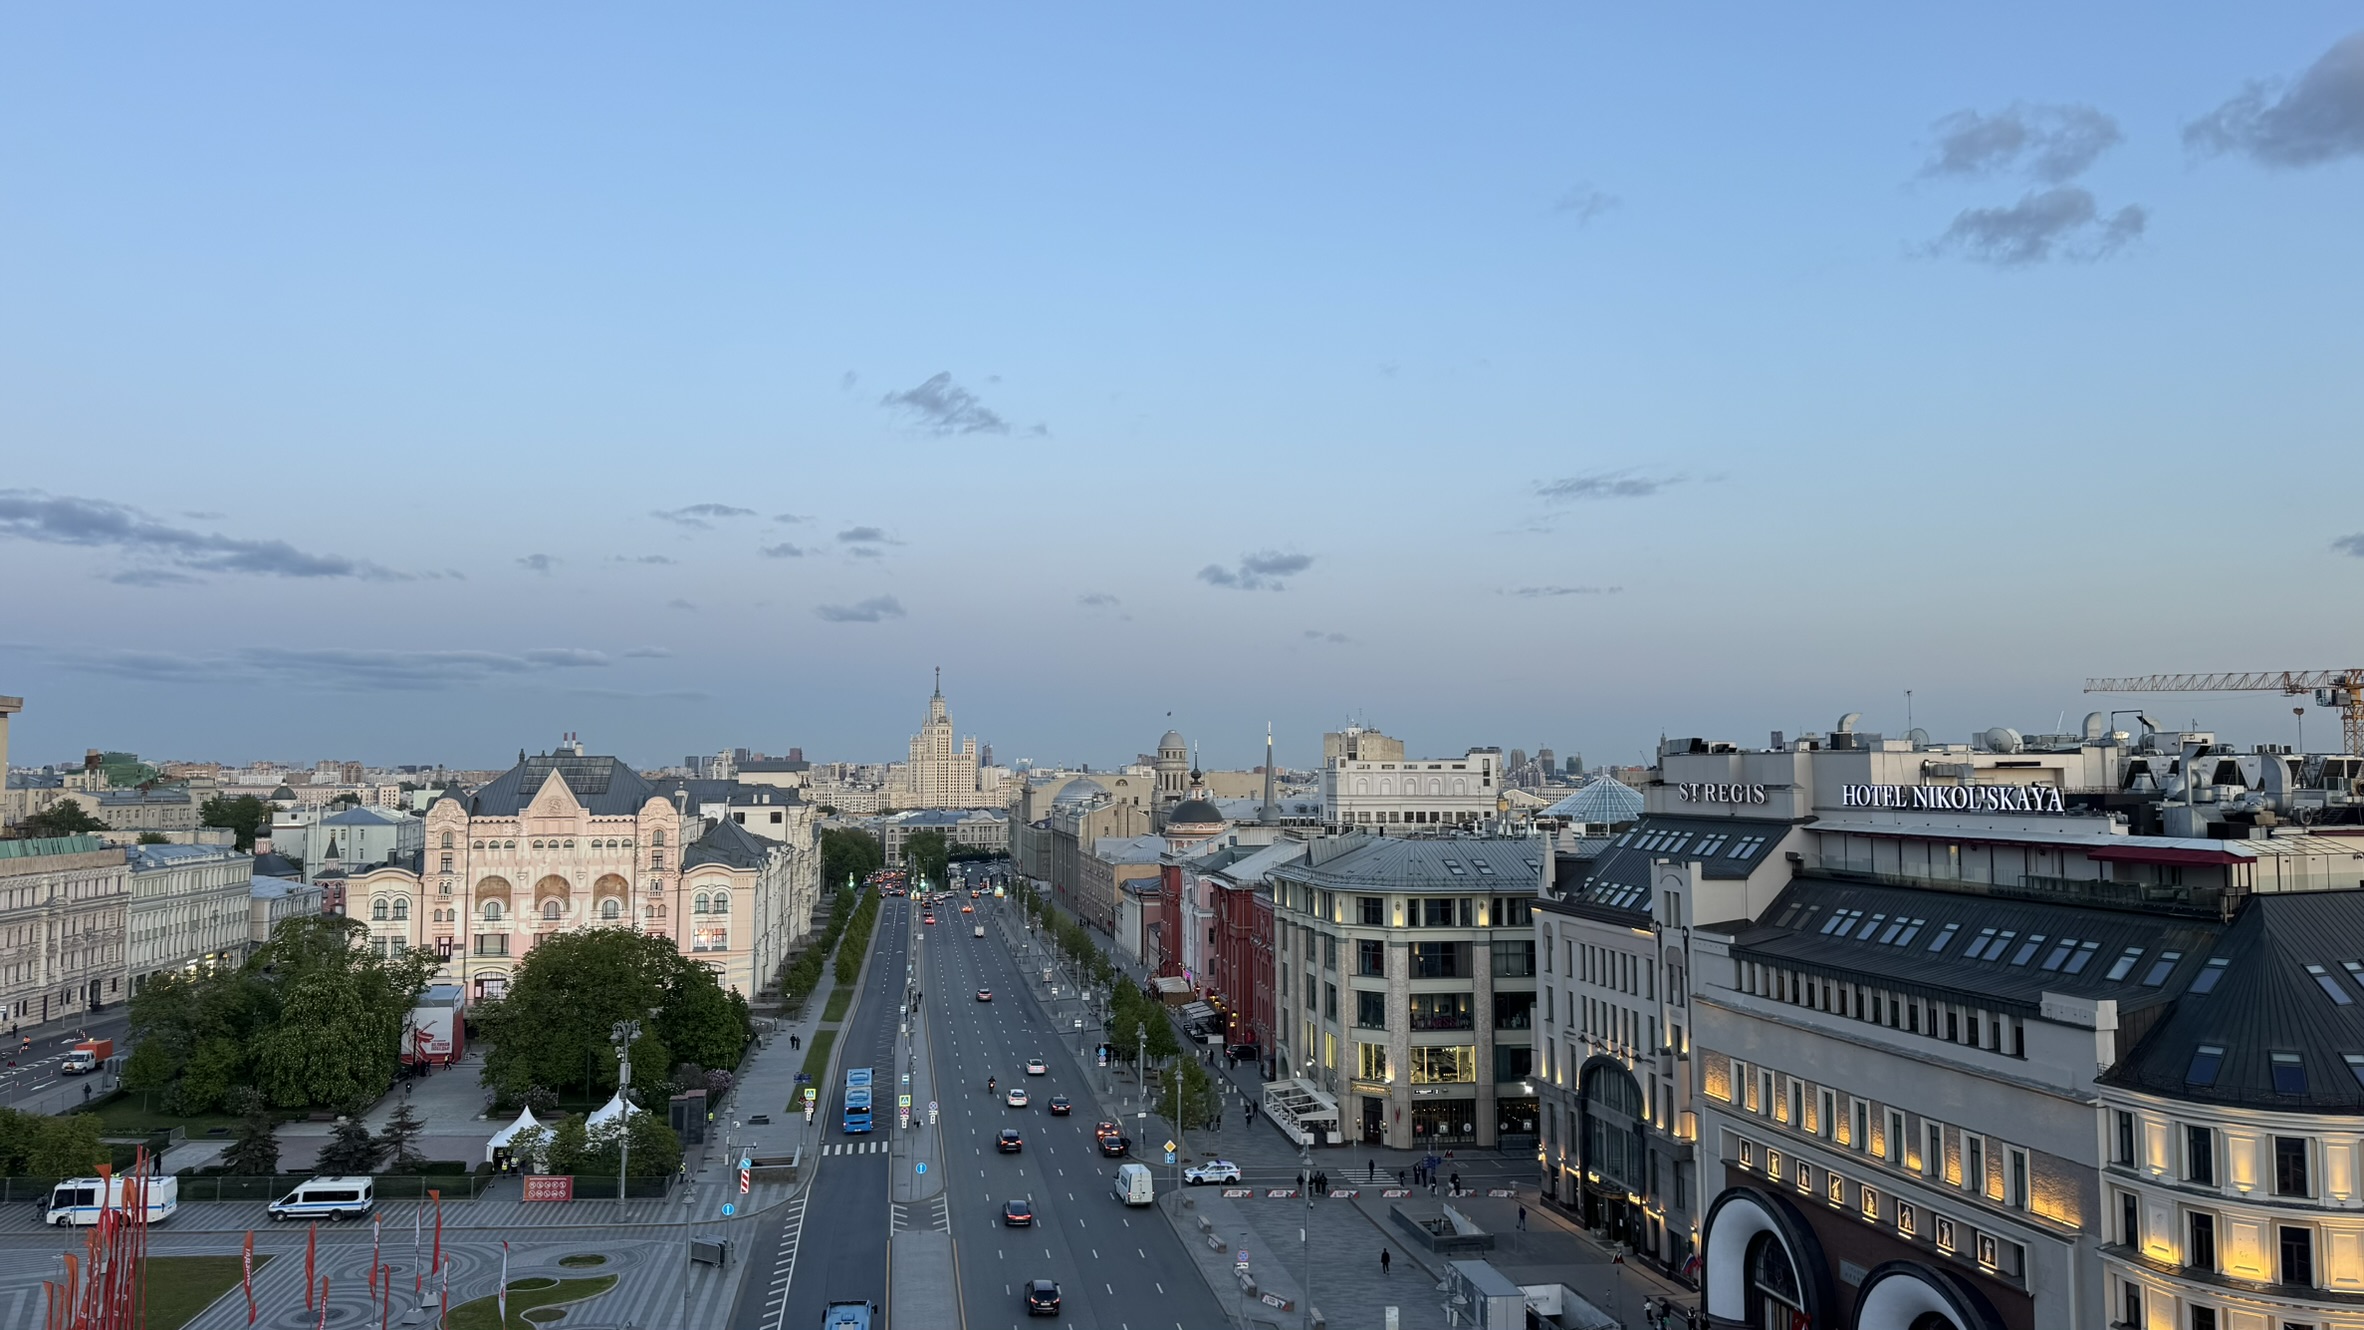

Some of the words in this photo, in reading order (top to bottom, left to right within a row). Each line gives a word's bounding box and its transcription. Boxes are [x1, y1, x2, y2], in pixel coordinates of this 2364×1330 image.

[1705, 783, 1765, 804] REGIS
[1842, 785, 1907, 808] HOTEL
[1913, 786, 2065, 812] NIKOL'SKAYA
